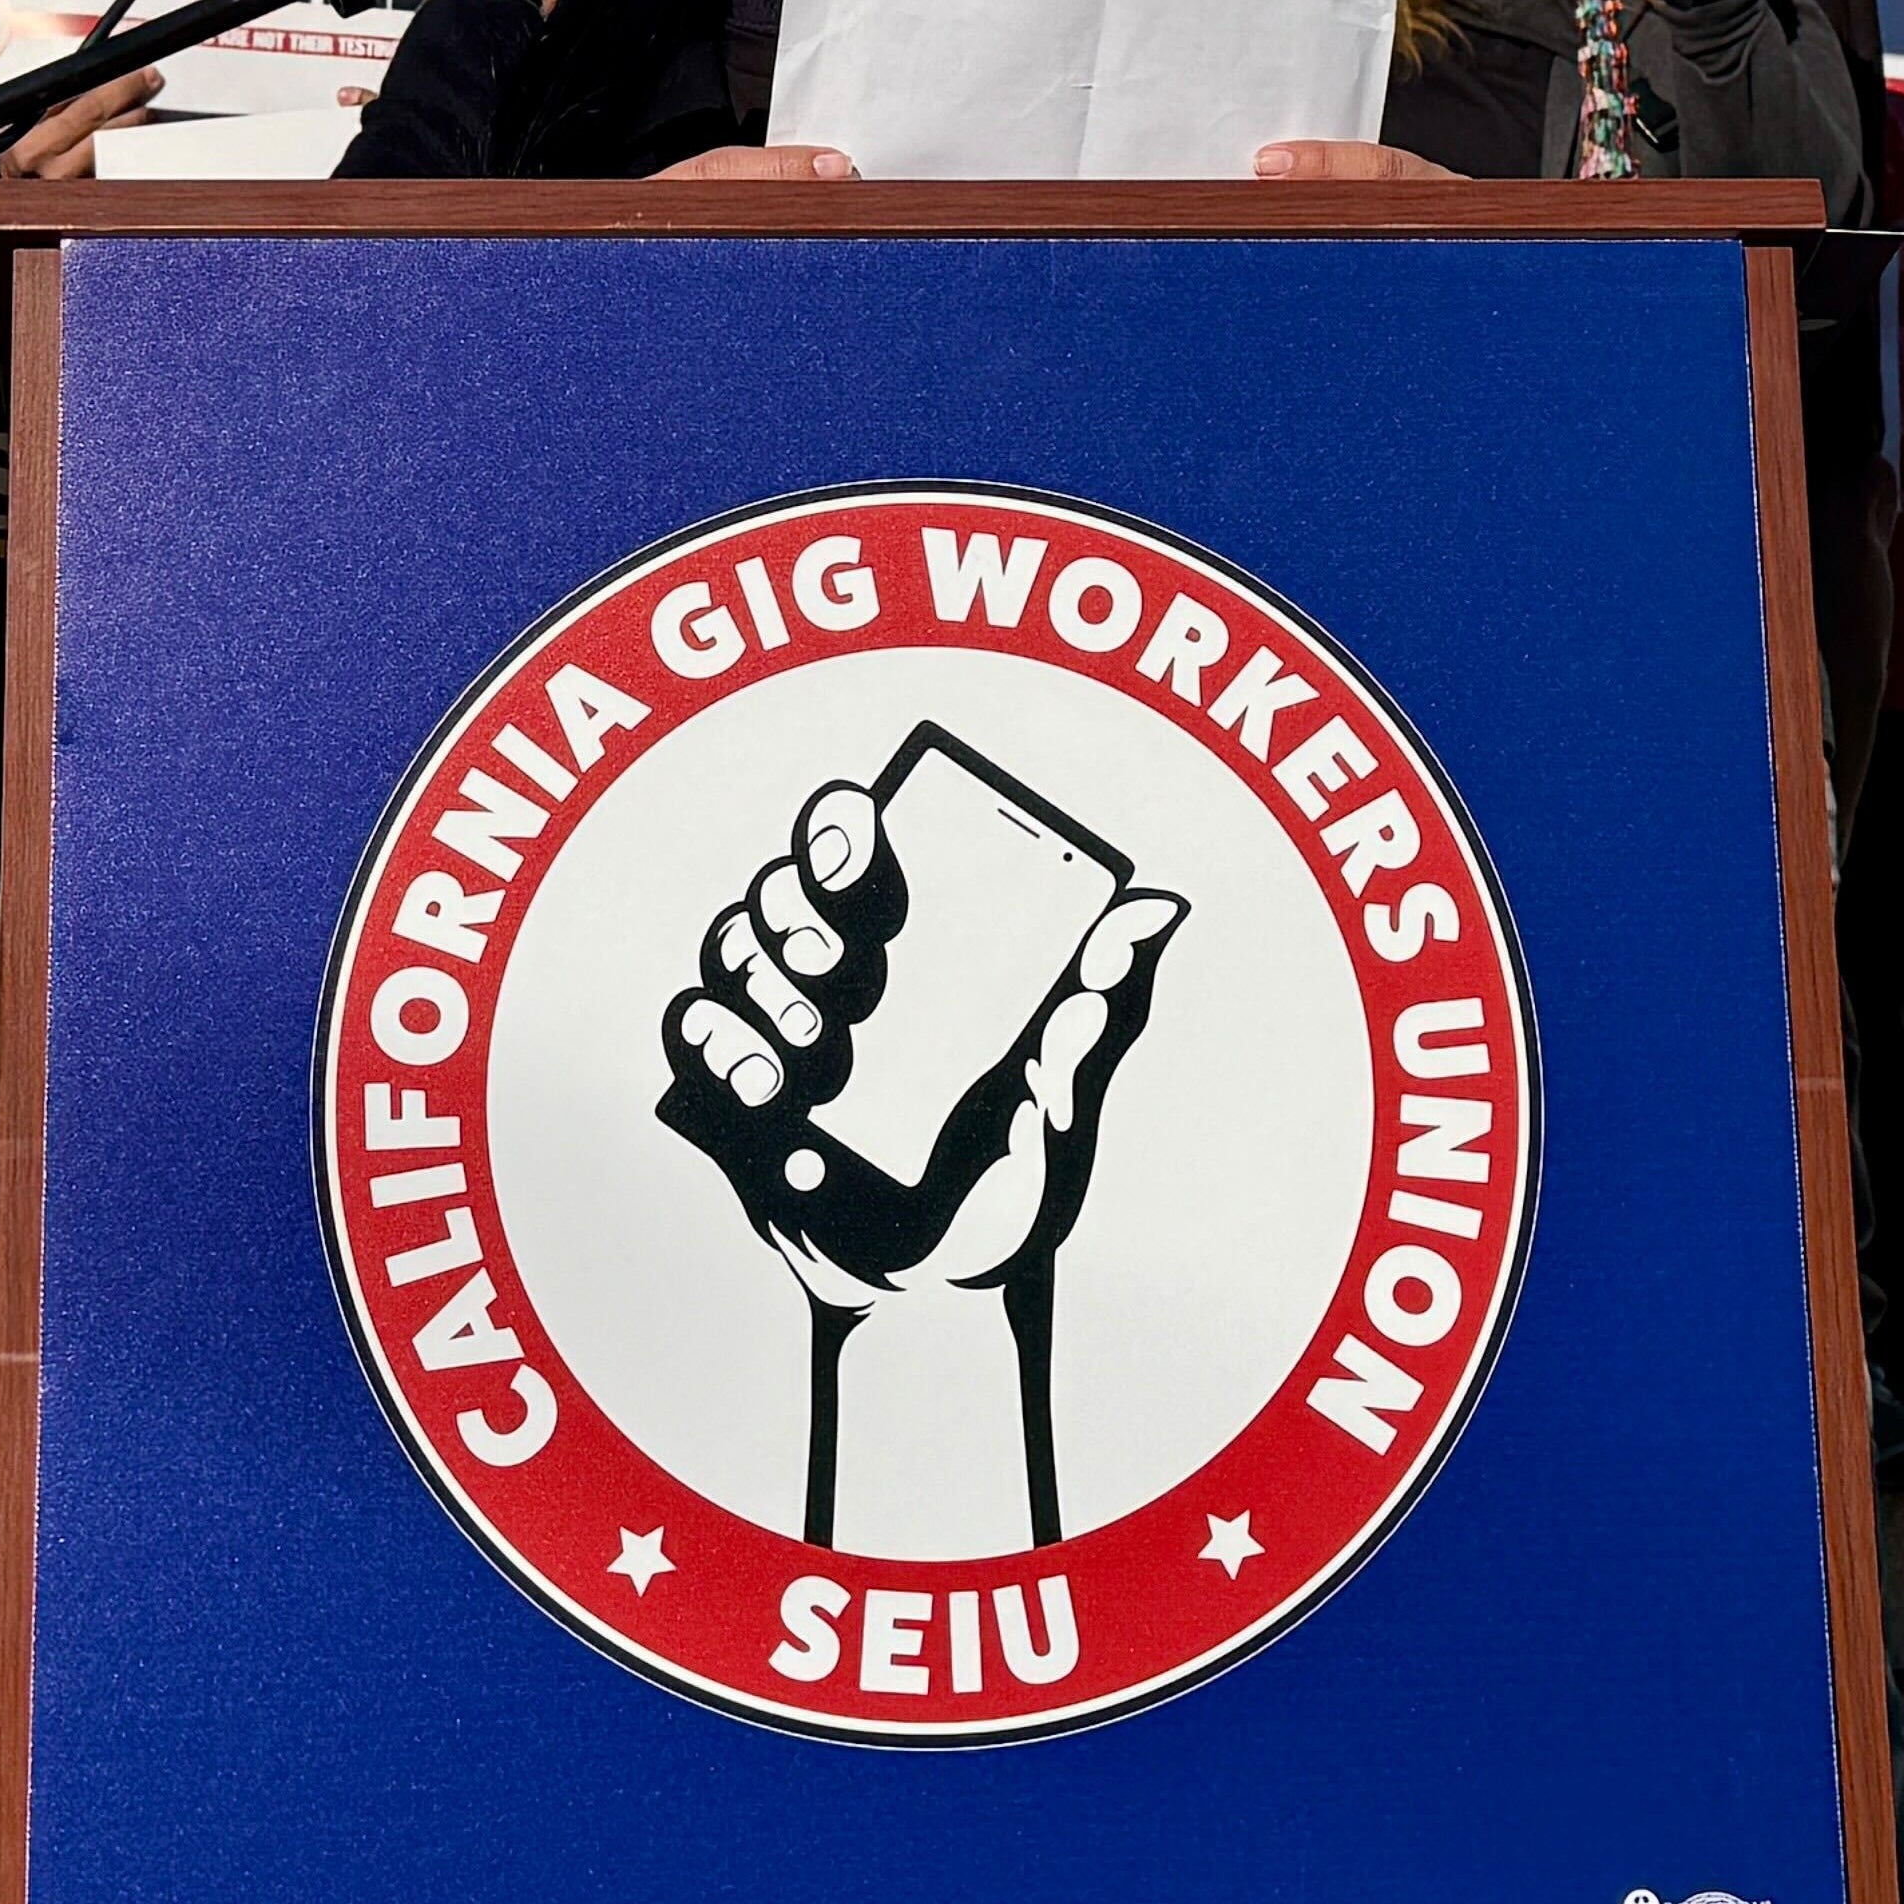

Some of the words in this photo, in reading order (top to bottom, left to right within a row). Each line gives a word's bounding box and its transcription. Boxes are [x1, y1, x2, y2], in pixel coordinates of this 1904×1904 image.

[364, 664, 652, 1470] CALIFORNIA
[648, 534, 884, 680] GIG
[920, 526, 1461, 966] WORKERS
[1305, 997, 1494, 1456] UNION
[767, 1573, 1082, 1696] SEIU
